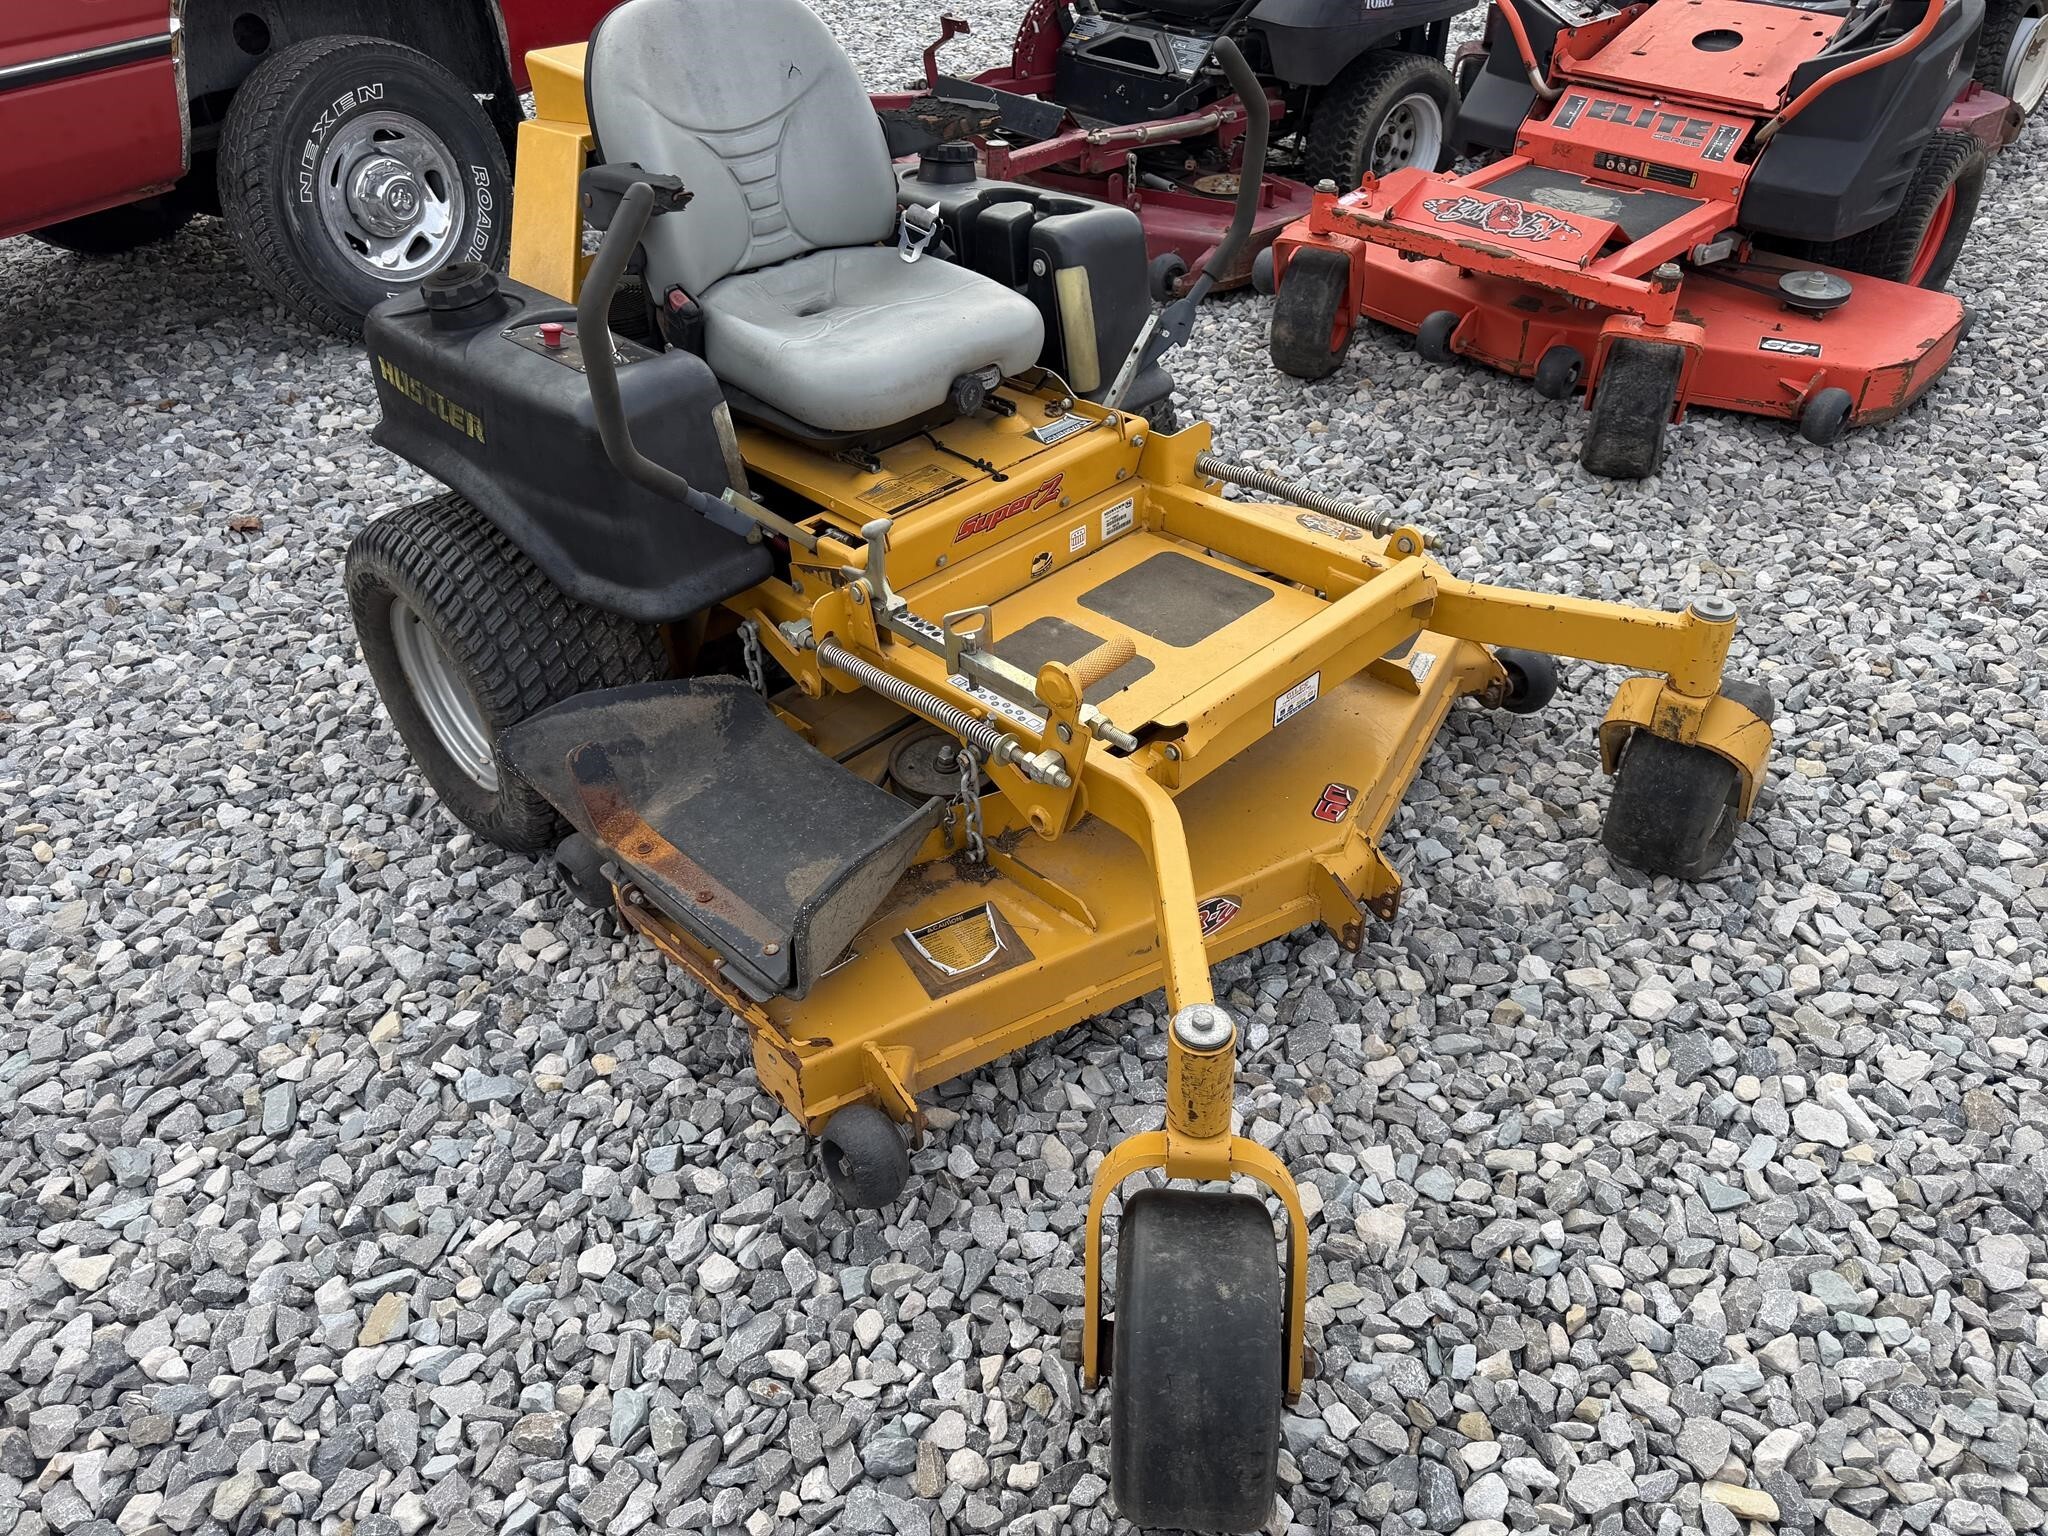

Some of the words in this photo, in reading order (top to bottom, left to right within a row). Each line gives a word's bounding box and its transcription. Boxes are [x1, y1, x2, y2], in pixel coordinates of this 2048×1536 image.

[300, 83, 384, 203] NEXEN
[1586, 99, 1713, 140] ELITE
[378, 355, 486, 444] HUSTLER
